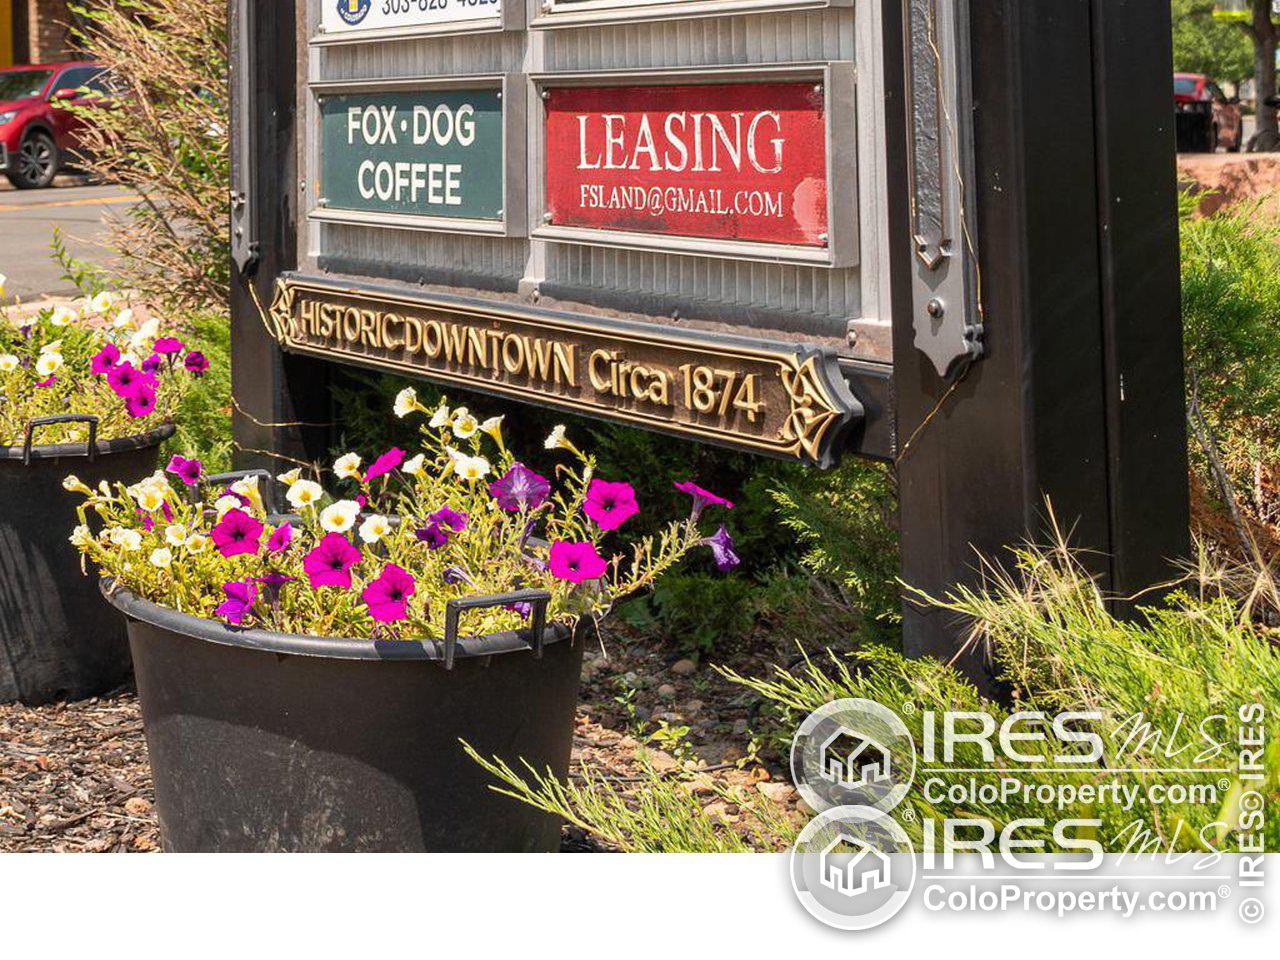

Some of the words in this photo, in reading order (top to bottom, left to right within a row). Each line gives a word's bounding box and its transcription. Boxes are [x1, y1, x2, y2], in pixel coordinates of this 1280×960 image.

[576, 110, 786, 174] LEASING
[357, 158, 463, 206] COFFEE
[580, 184, 783, 218] FSLAND@GMAIL.COM
[403, 318, 576, 388] DOWNTOWN
[587, 348, 670, 406] Circa
[678, 362, 762, 422] 1874
